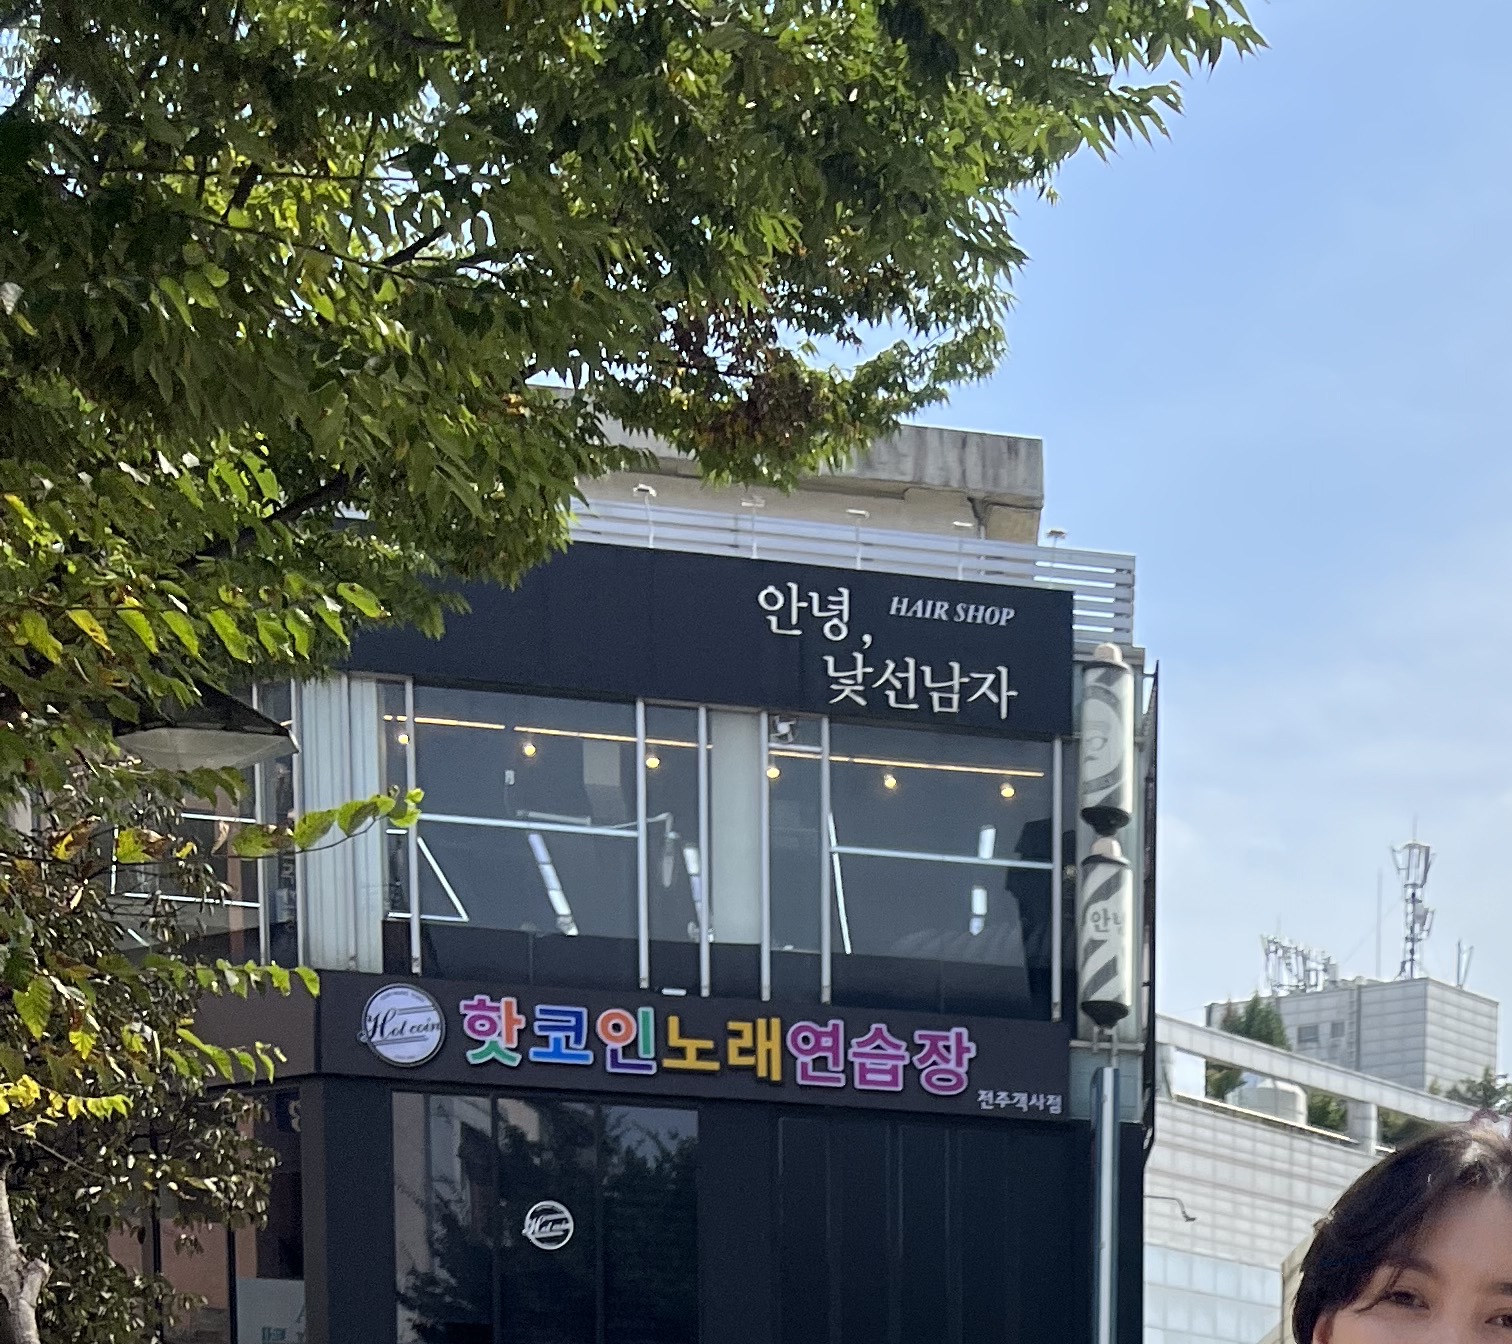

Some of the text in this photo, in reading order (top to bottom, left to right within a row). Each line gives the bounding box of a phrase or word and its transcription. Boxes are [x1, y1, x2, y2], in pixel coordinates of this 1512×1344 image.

[758, 581, 873, 650] 안녕,
[889, 596, 1016, 626] HAIR SHOP
[822, 651, 1018, 720] 낯선남자
[977, 1089, 1063, 1115] 전주객사점
